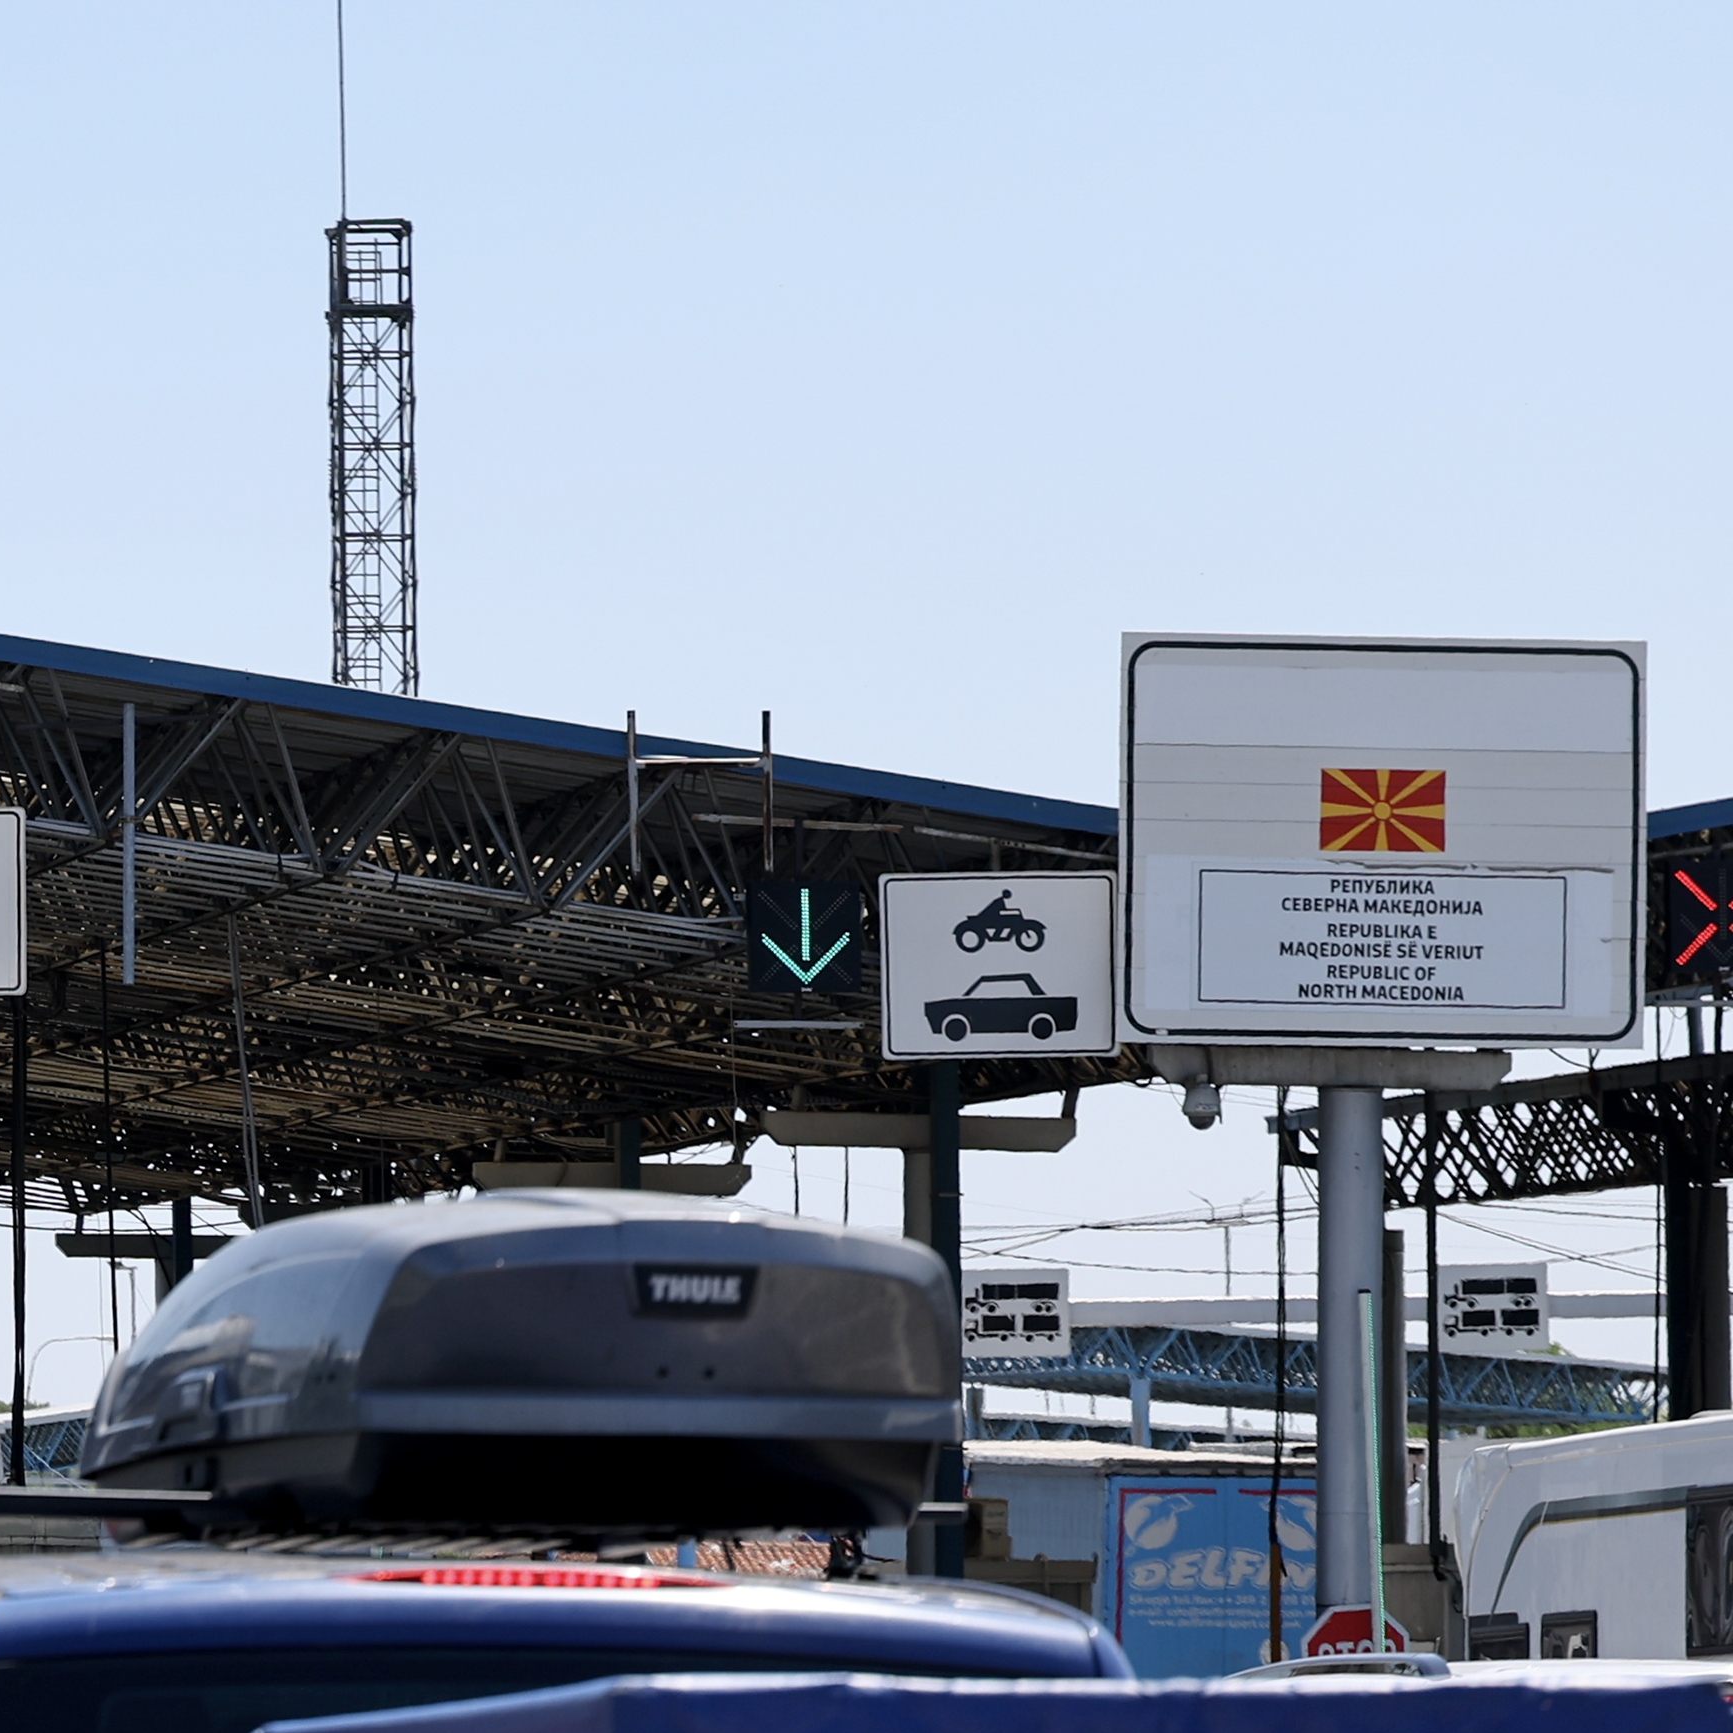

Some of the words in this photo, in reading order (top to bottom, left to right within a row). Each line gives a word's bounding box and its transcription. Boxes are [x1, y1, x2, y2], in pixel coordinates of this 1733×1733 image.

[1330, 879, 1435, 894] РЕПУБЛИКА
[1281, 897, 1359, 913] СЕВЕРНА
[1363, 898, 1484, 917] МАКЕДОНИЈА
[1327, 923, 1422, 939] REPUBLIKA
[1427, 925, 1438, 939] E
[1279, 941, 1392, 960] MAQEDONISË
[1396, 942, 1417, 958] SË
[1422, 945, 1484, 960] VERIUT
[1327, 964, 1410, 981] REPUBLIC
[1414, 966, 1436, 981] OF
[1298, 983, 1357, 999] NORTH
[1361, 985, 1464, 1001] MACEDONIA
[649, 1273, 741, 1304] THULE
